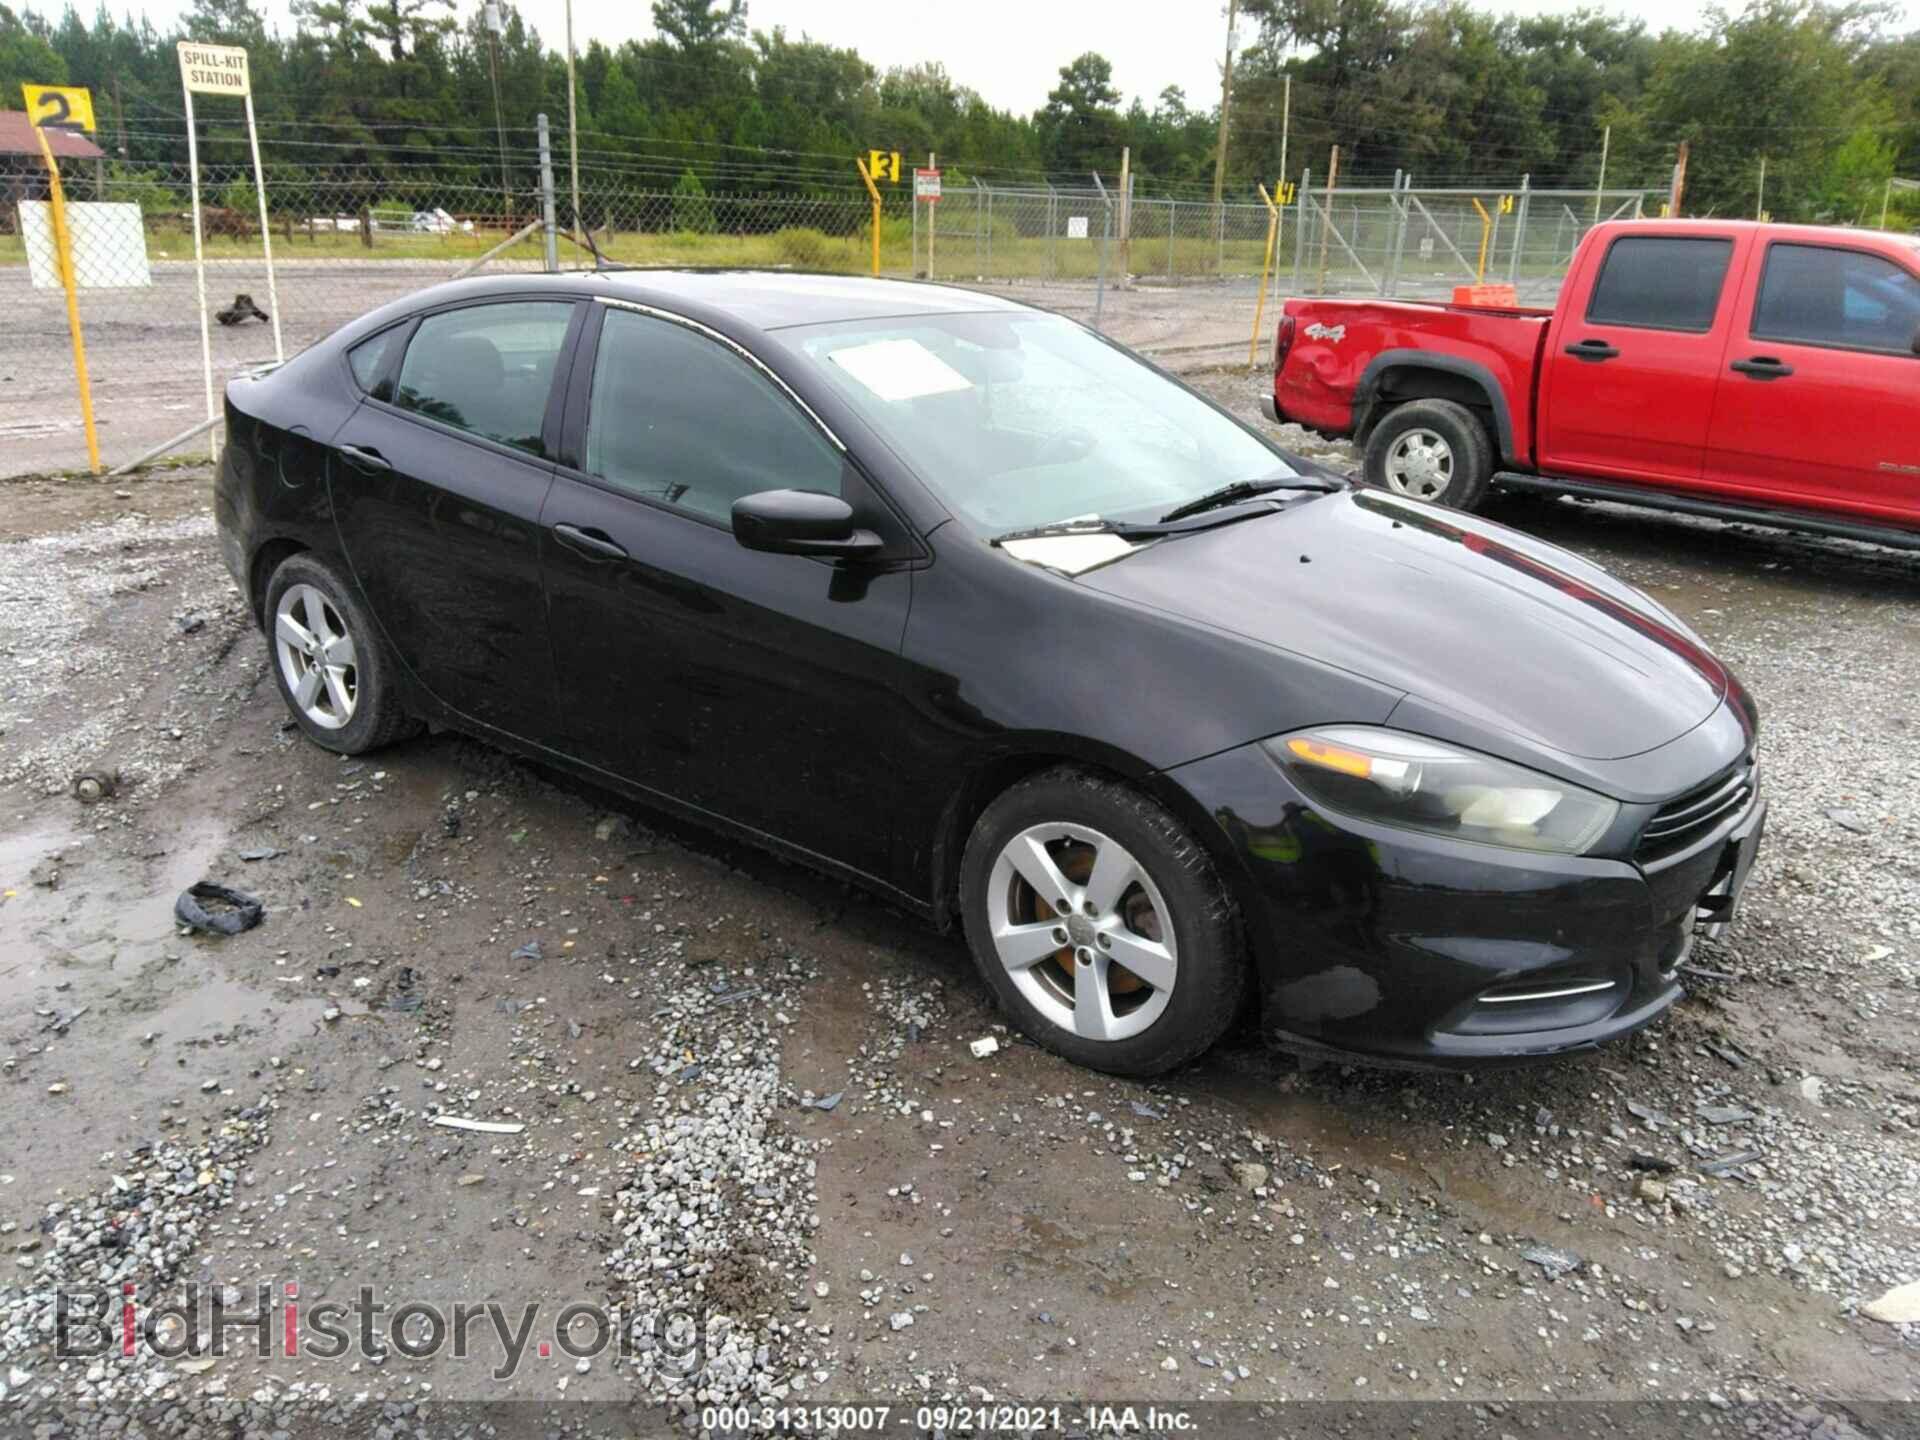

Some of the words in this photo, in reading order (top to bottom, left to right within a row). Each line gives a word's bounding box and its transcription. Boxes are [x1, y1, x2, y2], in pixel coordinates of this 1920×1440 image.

[184, 51, 244, 69] SPILL-KIT
[191, 70, 242, 87] STATION
[37, 91, 85, 132] 2
[878, 152, 893, 181] 3
